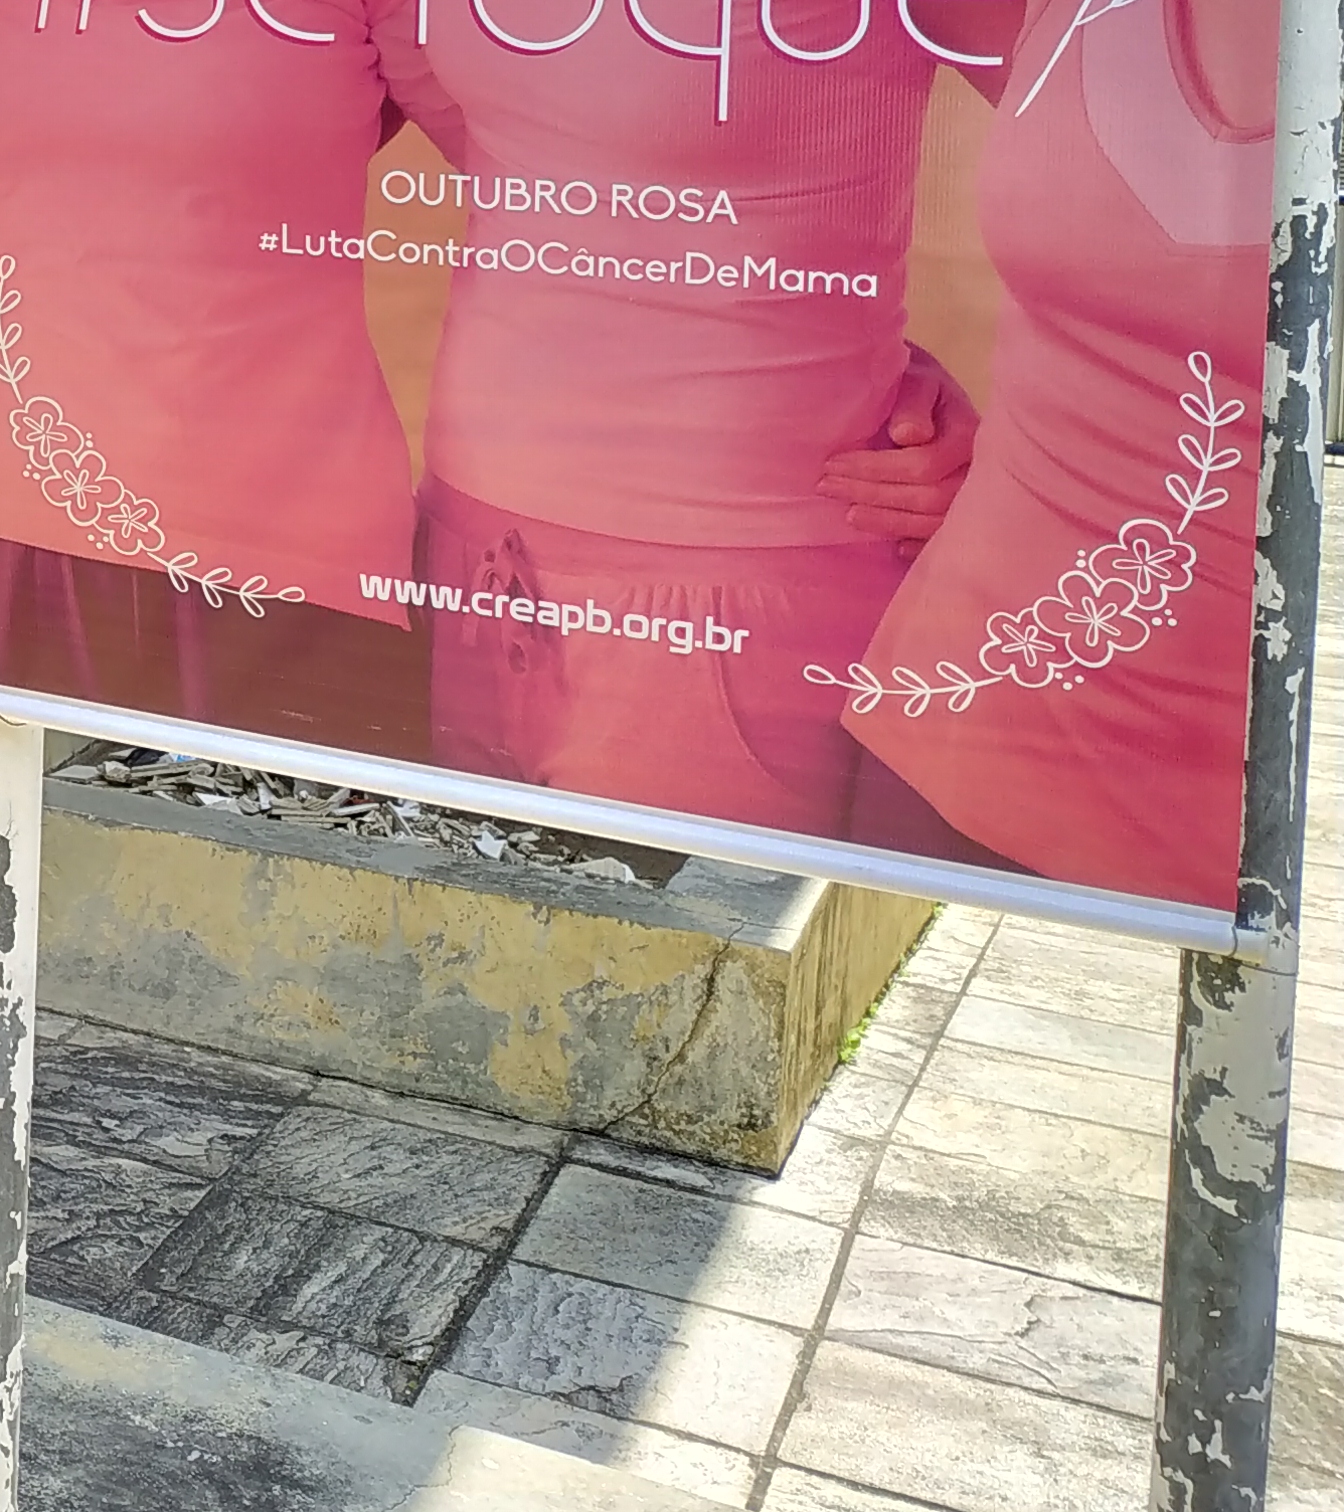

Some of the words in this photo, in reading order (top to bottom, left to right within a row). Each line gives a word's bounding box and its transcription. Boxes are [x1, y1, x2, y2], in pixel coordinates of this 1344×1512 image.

[381, 169, 598, 217] OUTUBRO
[610, 184, 739, 226] ROSA
[258, 222, 879, 299] #LutaContraOCâncerDeMama
[358, 572, 750, 655] www.creapb.org.br
